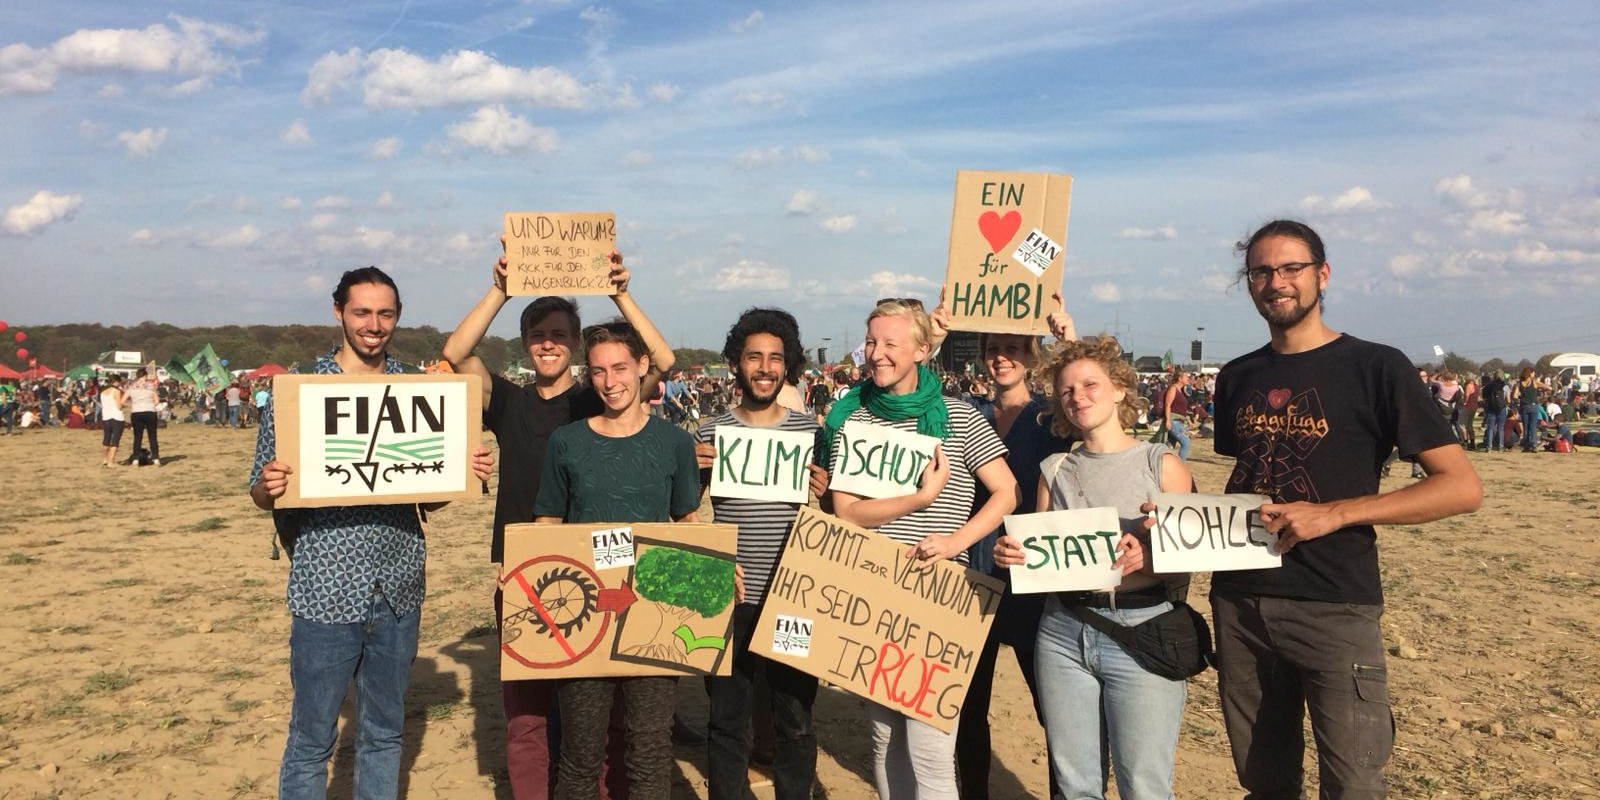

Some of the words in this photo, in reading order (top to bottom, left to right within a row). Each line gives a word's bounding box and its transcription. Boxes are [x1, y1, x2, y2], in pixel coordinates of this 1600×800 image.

[981, 182, 1025, 207] EIN
[510, 216, 554, 239] UND
[557, 218, 616, 242] WARUM?
[1026, 231, 1060, 261] FIAN
[521, 245, 539, 258] NUR
[568, 246, 590, 260] DEN
[567, 262, 588, 273] DEN
[978, 252, 1008, 278] für
[952, 281, 1043, 320] HAMBI
[324, 385, 445, 435] FIAN
[836, 433, 933, 486] ASCHUT
[592, 530, 632, 548] FIAN
[1154, 505, 1268, 552] KOHLE
[790, 511, 869, 570] KOMMT
[859, 559, 888, 578] ZUR
[893, 548, 1001, 623] VERNUNFT
[1023, 531, 1118, 571] STATT
[772, 566, 815, 608] IHR
[816, 584, 871, 627] SEID
[875, 609, 920, 649] AUF
[925, 631, 974, 674] DEM
[776, 617, 813, 636] FIAN
[828, 636, 963, 720] IRRWEG
